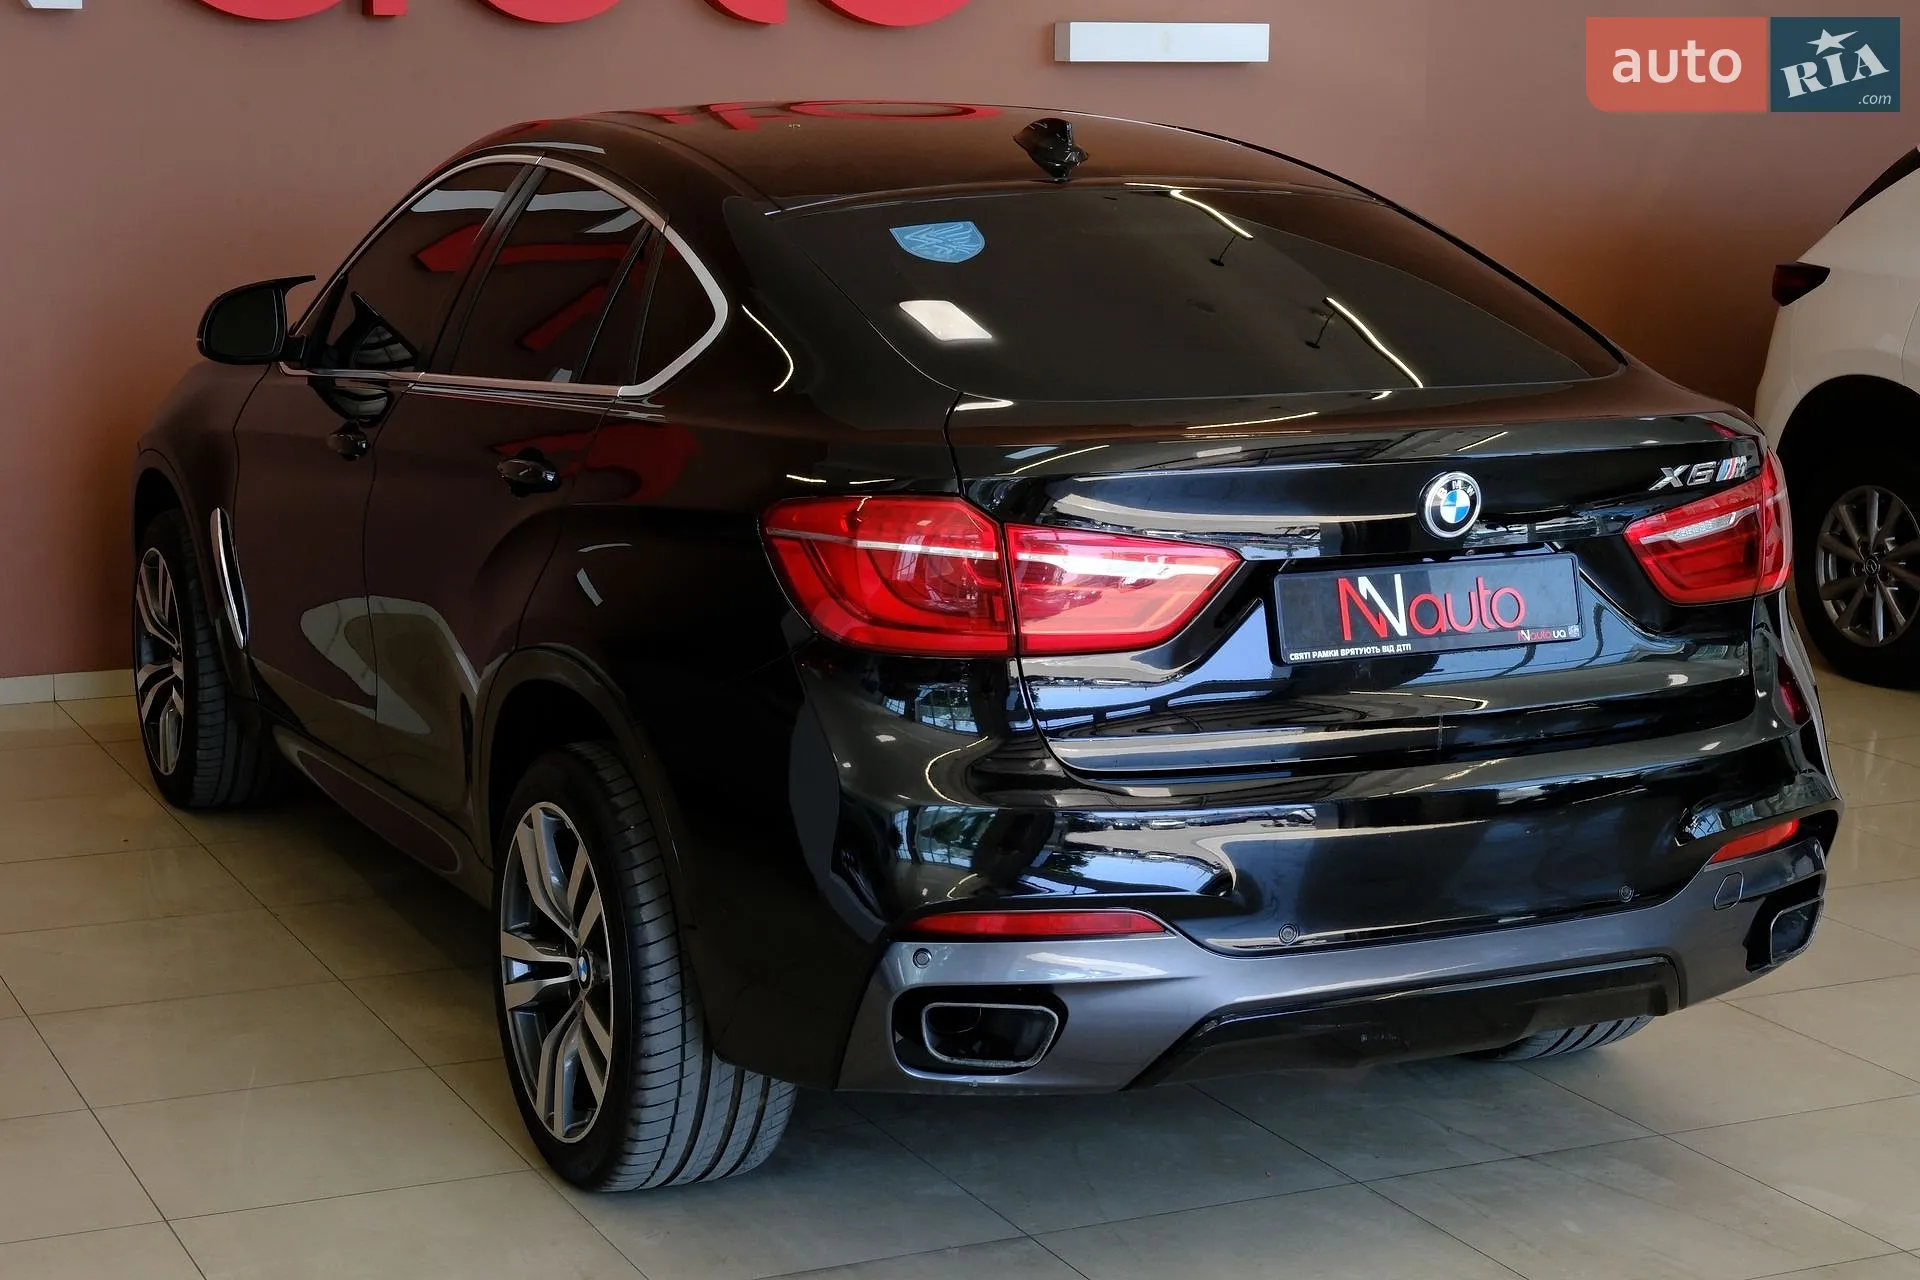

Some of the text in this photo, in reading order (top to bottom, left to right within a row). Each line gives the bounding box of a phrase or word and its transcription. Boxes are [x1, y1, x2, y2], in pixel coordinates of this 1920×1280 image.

[1436, 479, 1476, 498] BMW
[1289, 643, 1412, 661] СВЯТІ РАМКИ ВРЯТУЮТЬ ВІД ДТП
